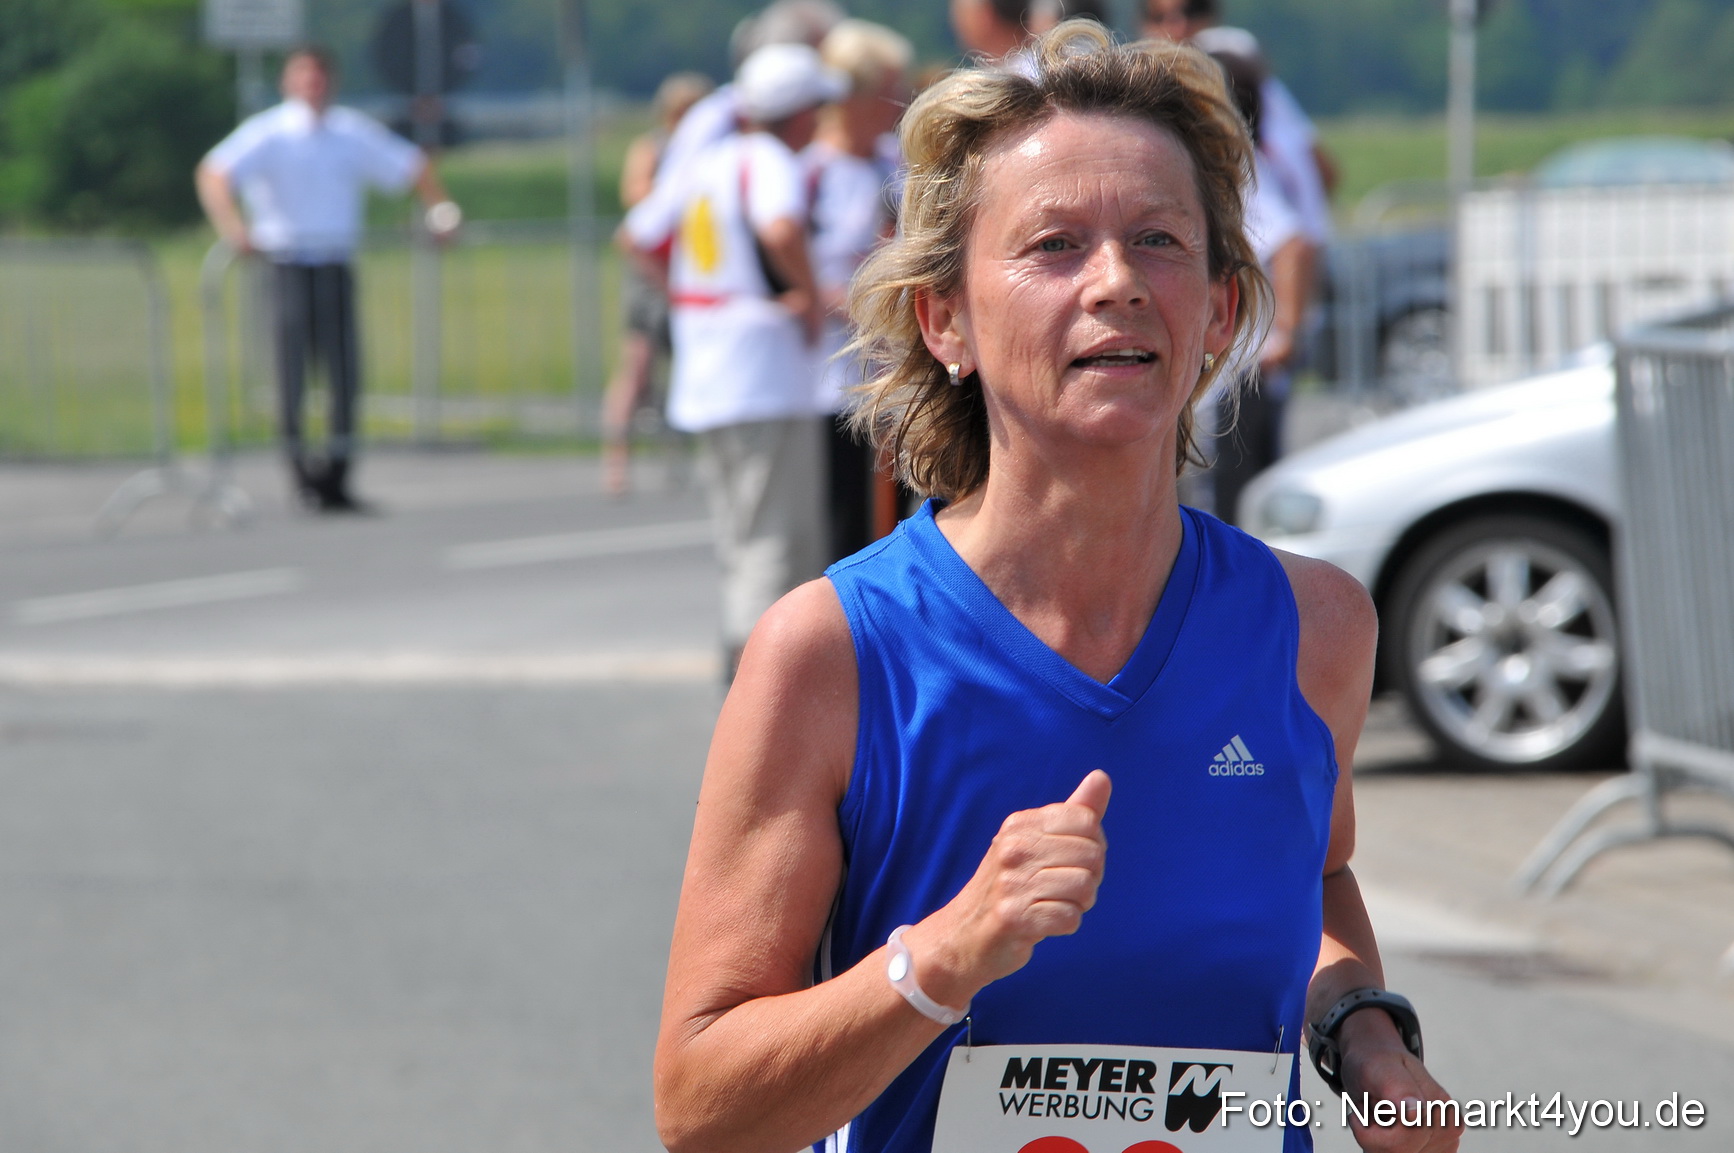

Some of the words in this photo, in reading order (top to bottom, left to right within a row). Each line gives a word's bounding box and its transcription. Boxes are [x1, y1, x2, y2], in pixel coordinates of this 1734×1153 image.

[1208, 761, 1265, 776] adidas
[1000, 1057, 1157, 1094] MEYER
[999, 1092, 1154, 1122] WERBUNG
